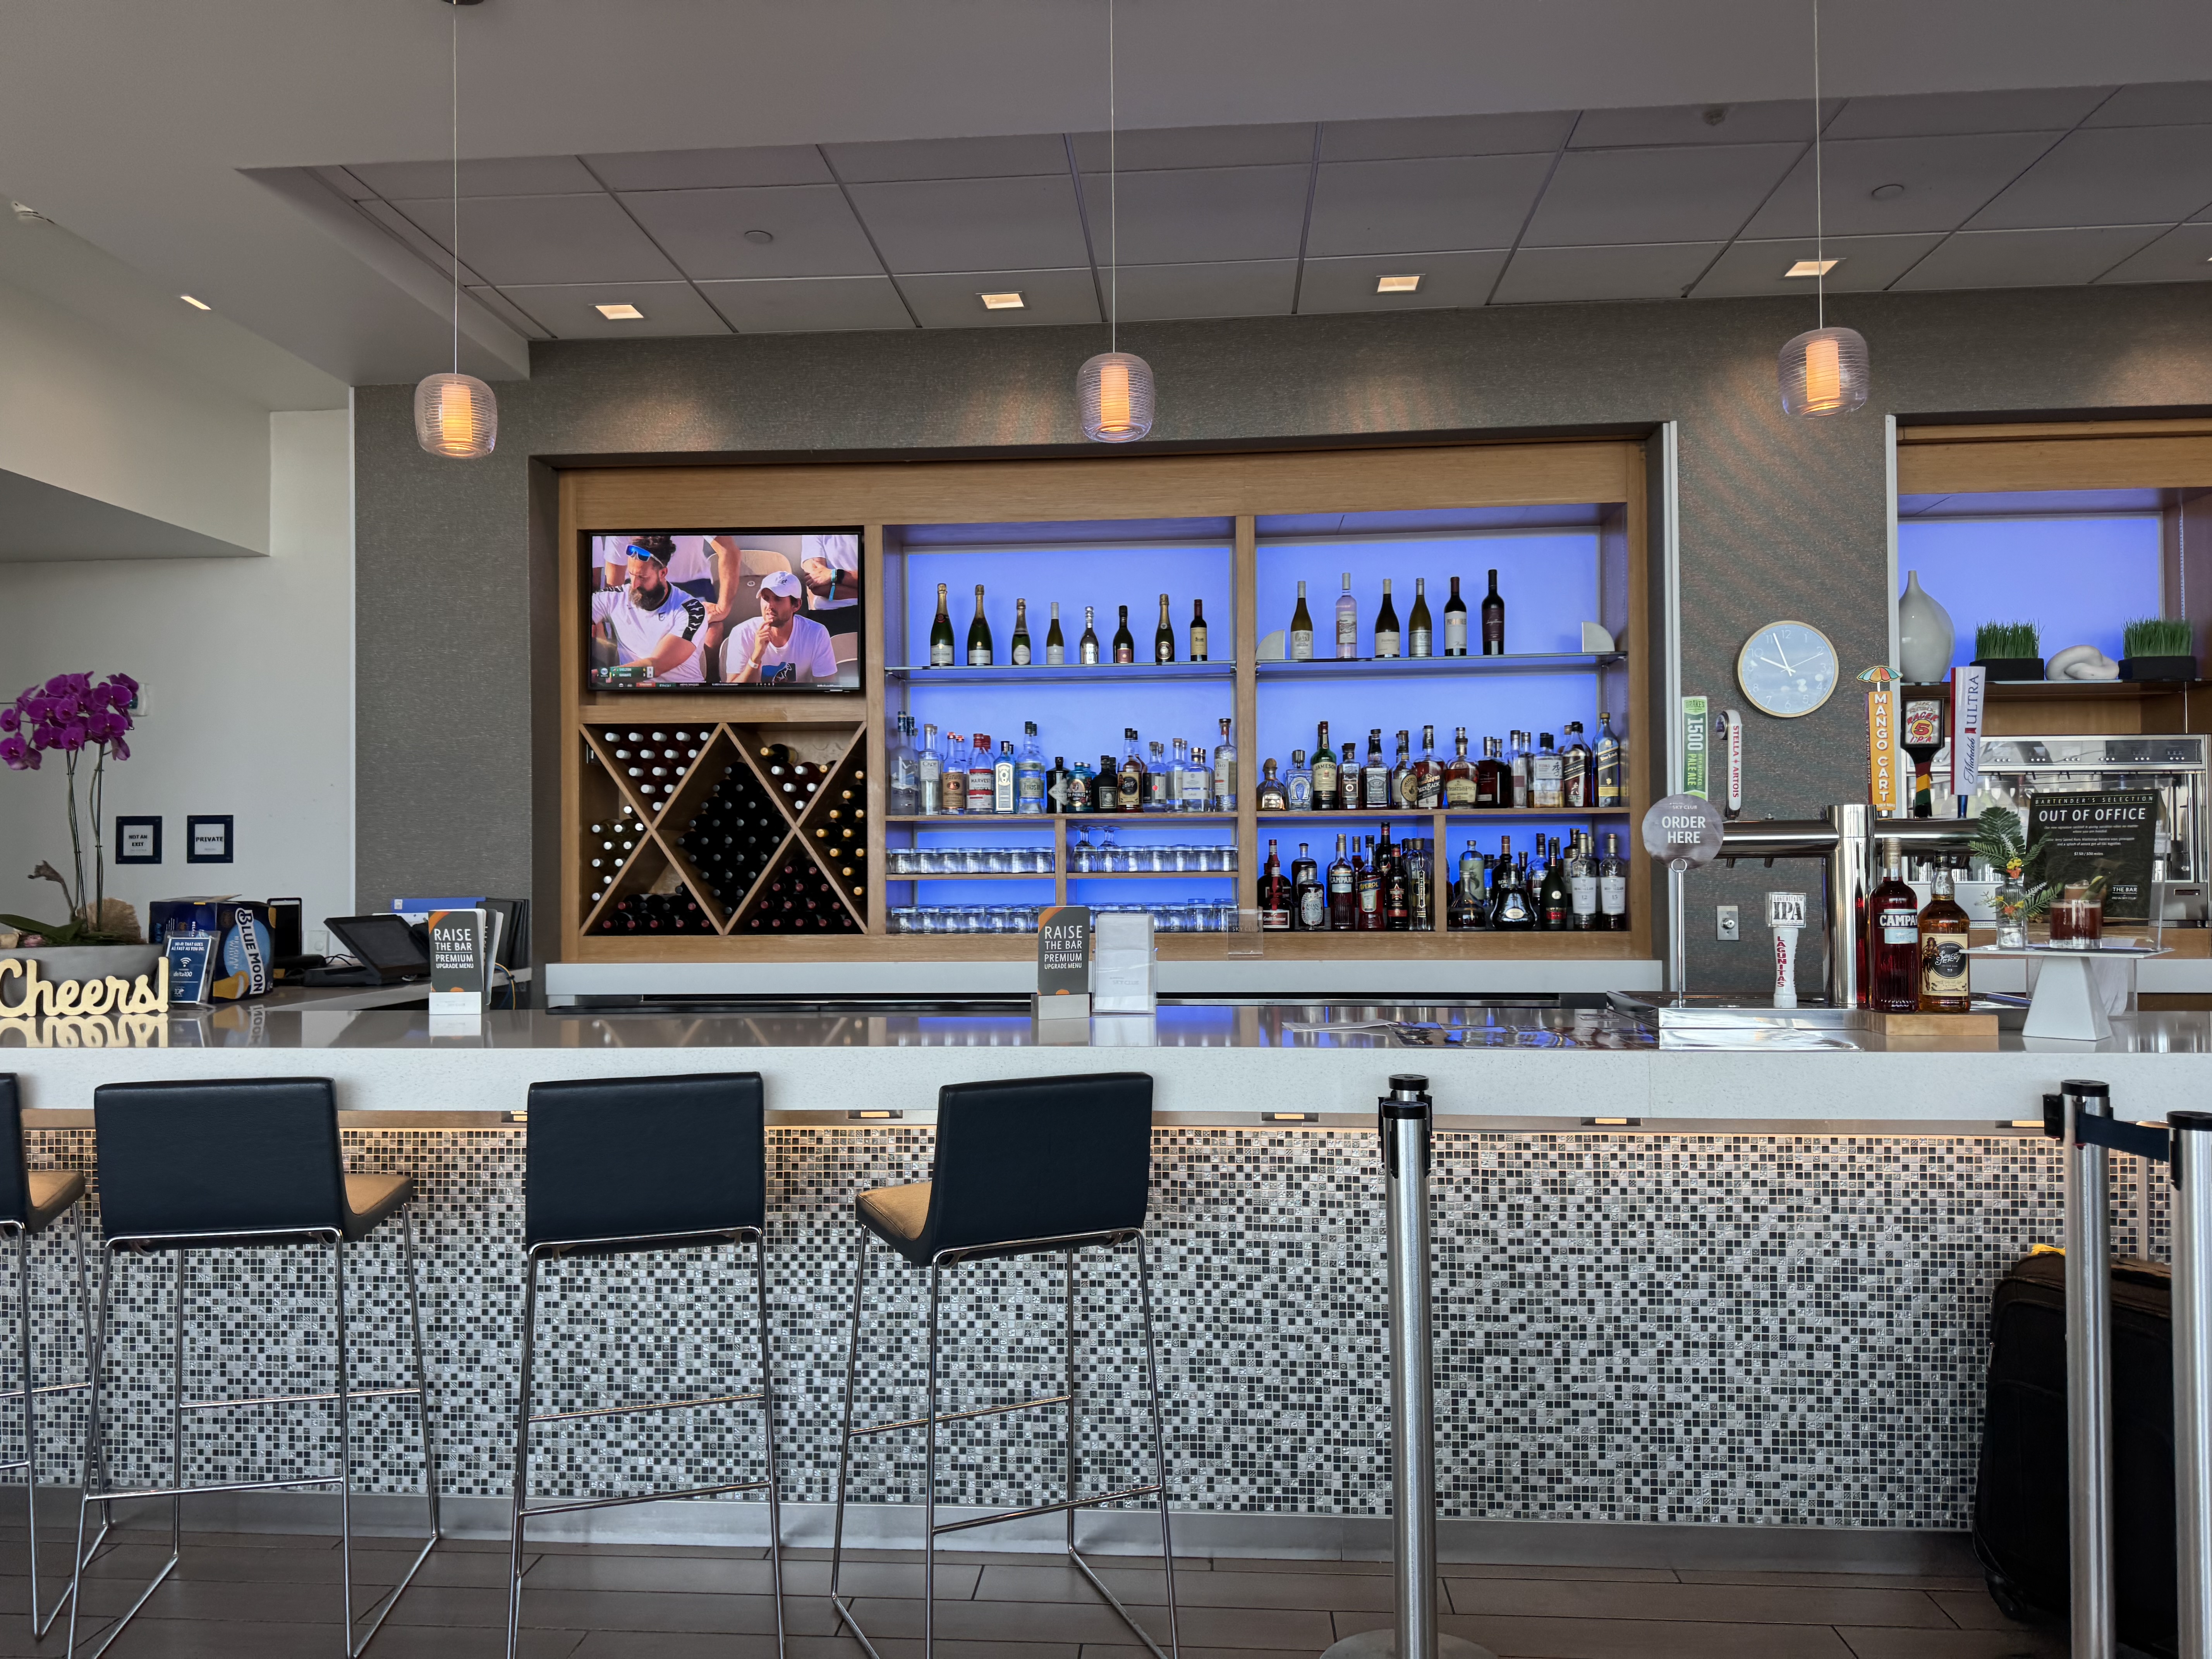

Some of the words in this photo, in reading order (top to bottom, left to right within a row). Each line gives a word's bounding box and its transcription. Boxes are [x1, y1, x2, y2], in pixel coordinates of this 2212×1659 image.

[1766, 635, 1773, 644] 11
[1781, 630, 1791, 639] 12
[1748, 648, 1763, 658] 10
[1817, 646, 1823, 655] 2
[1820, 663, 1826, 672] 3
[1753, 684, 1759, 692] 8
[1766, 696, 1772, 706] 7
[1785, 700, 1791, 709] 6
[1802, 694, 1808, 704] 5
[1966, 675, 1979, 725] ULTRA
[1875, 694, 1888, 750] MANGO
[1907, 711, 1939, 725] RACER
[1687, 718, 1703, 750] 1500
[1913, 723, 1930, 735] 5
[1688, 754, 1697, 771] PALE
[1964, 737, 1975, 784] Michelob
[1688, 773, 1697, 786] ALE
[1877, 756, 1889, 801] CART
[2039, 810, 2067, 822] OUT
[2072, 809, 2090, 821] OF
[2095, 808, 2146, 821] OFFICE
[1662, 816, 1706, 828] ORDER
[1668, 831, 1701, 843] HERE
[1774, 902, 1803, 920] IPA
[1880, 915, 1917, 926] CAMPA
[237, 910, 256, 950] BLUE
[434, 929, 472, 941] RAISE
[1045, 926, 1083, 939] RAISE
[435, 942, 452, 951] THE
[454, 942, 472, 951] BAR
[1045, 941, 1061, 950] THE
[1065, 940, 1082, 949] BAR
[436, 954, 473, 962] PREMIUM
[1044, 953, 1082, 962] PREMIUM
[1777, 936, 1787, 987] LAGUNITAS
[248, 953, 263, 992] MOON
[0, 957, 168, 1017] Cheers!
